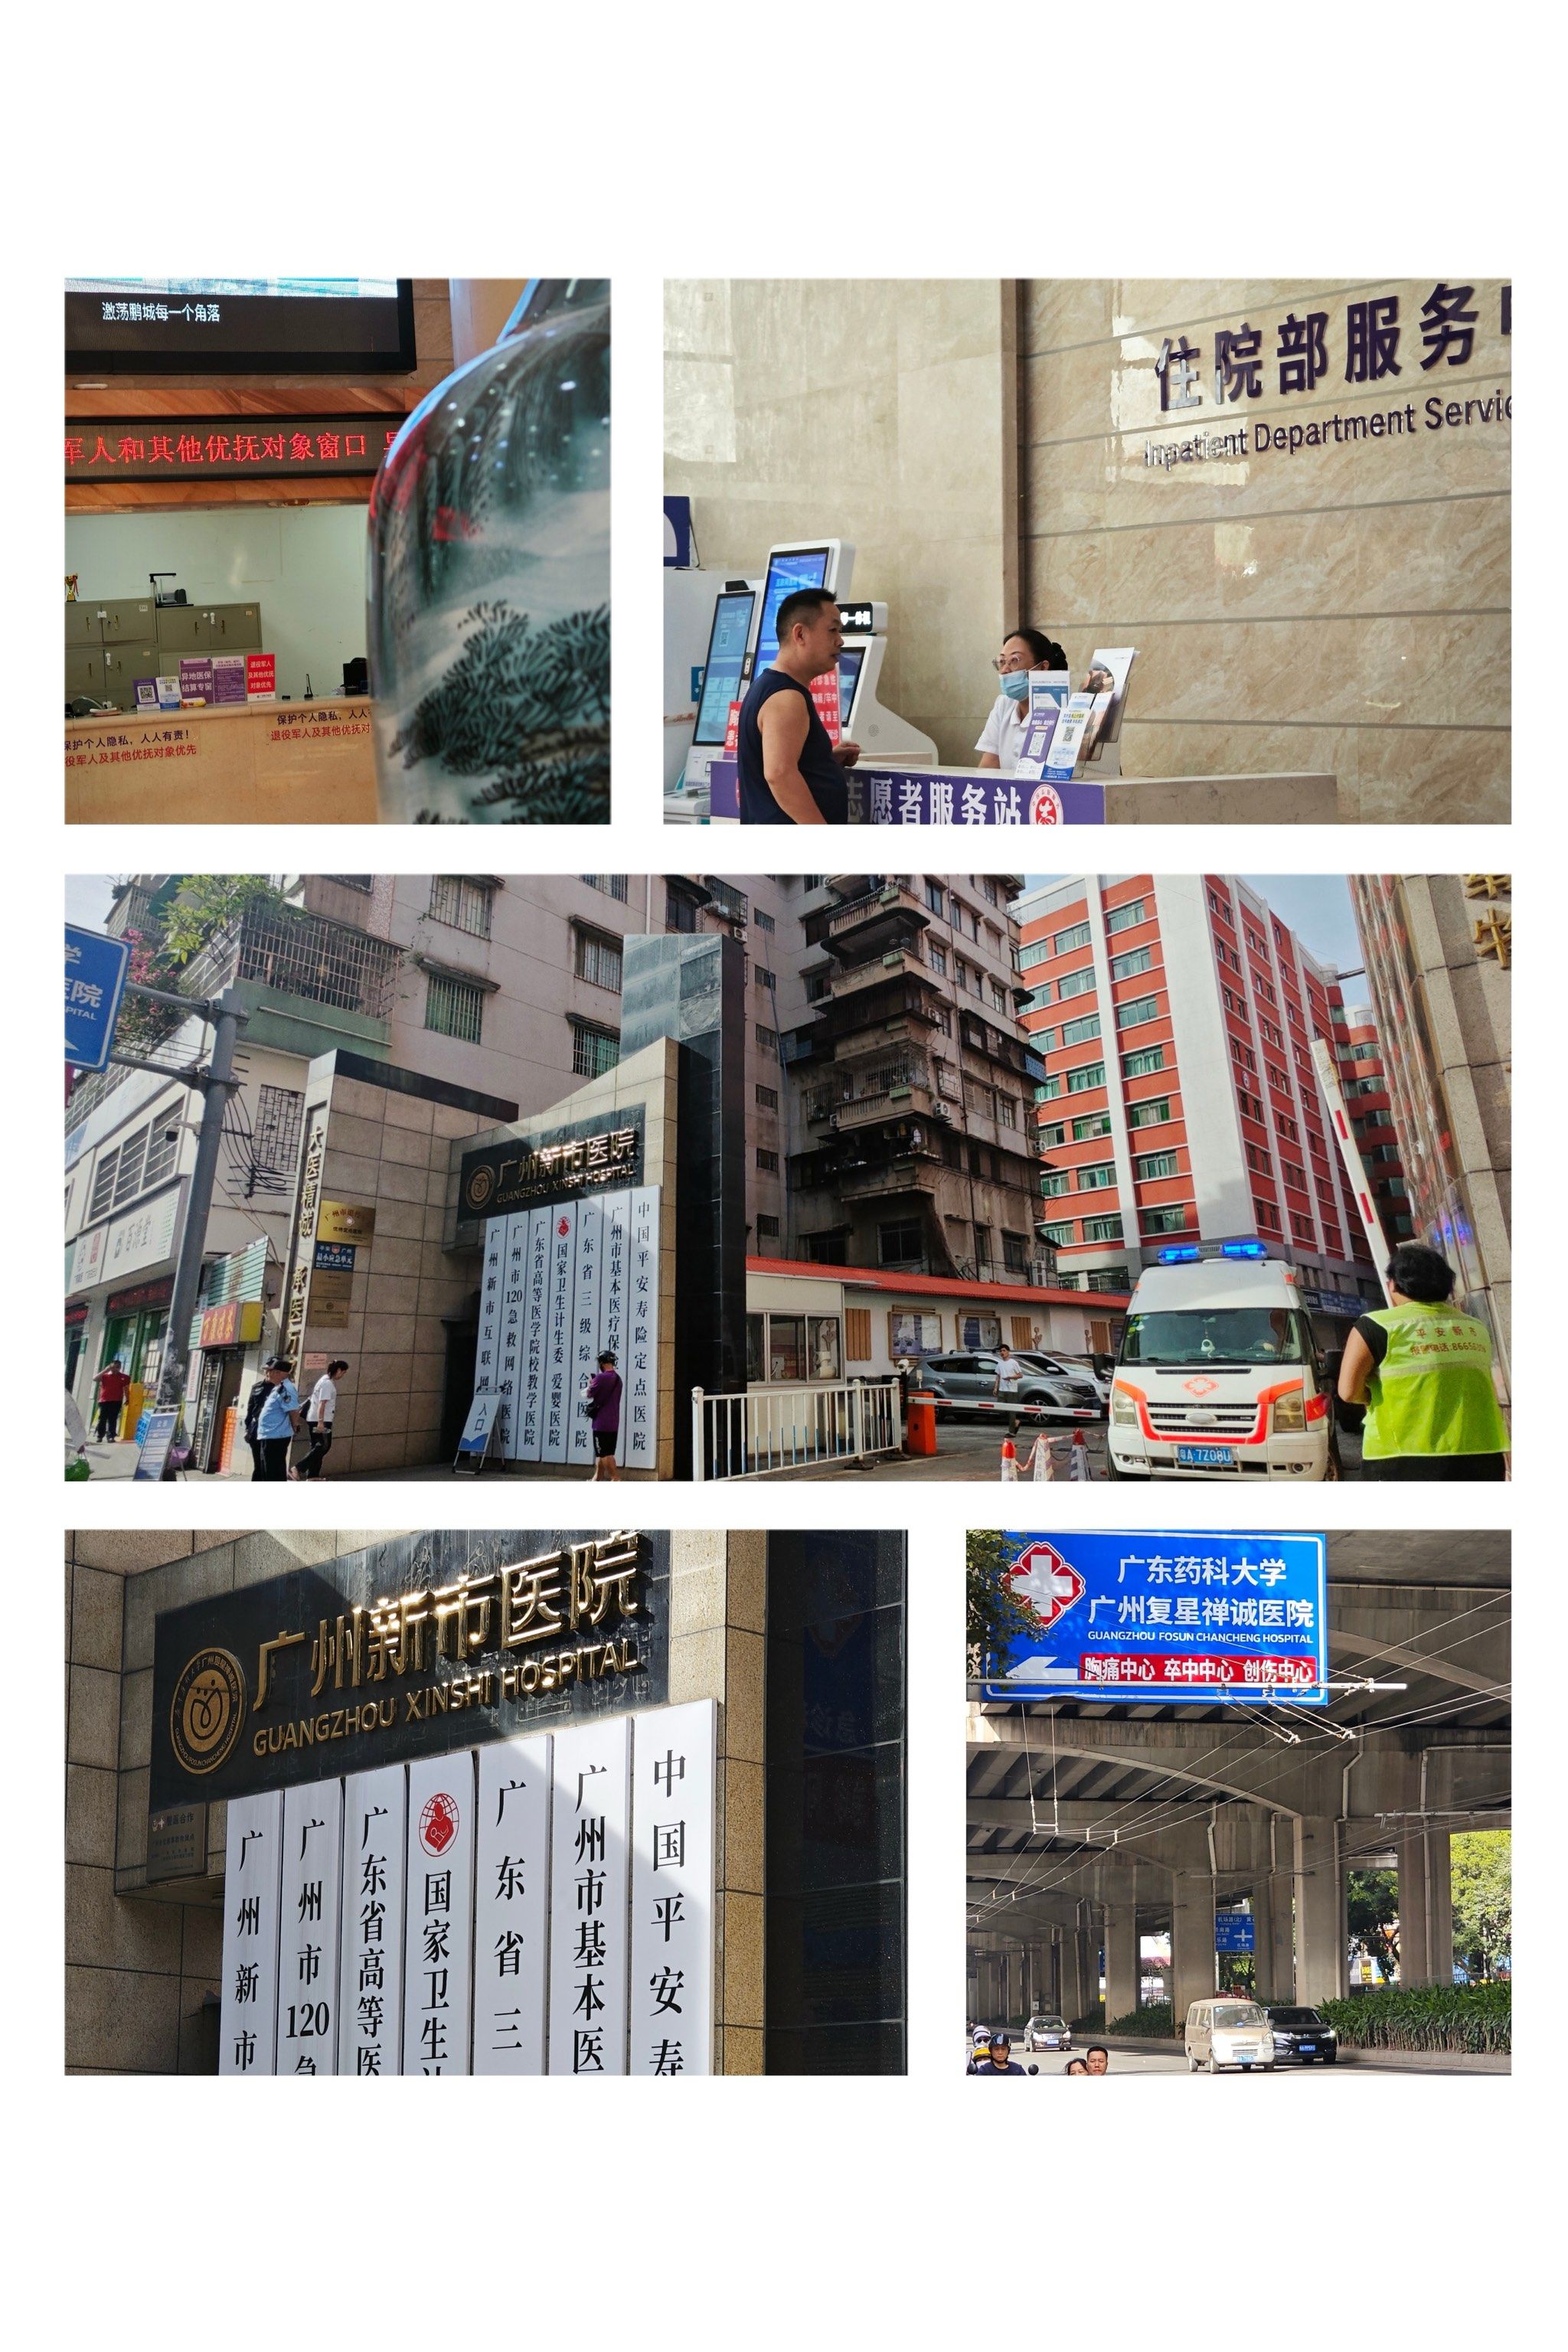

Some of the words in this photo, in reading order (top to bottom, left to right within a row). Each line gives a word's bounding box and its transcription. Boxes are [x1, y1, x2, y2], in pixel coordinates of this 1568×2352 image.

[102, 302, 220, 322] 激荡鹏城每一个角落
[1155, 282, 1512, 412] 住院部服务
[64, 432, 366, 466] 军人和其他优抚对象窗口
[1143, 426, 1249, 472] Inpatient
[1255, 402, 1417, 456] Department
[181, 671, 213, 681] 异地医保
[276, 708, 371, 726] 保护个人隐私，人人
[496, 1127, 635, 1188] 广州新市医院
[496, 1183, 550, 1204] GUANGZHOU
[552, 1173, 583, 1191] XINSHI
[586, 1163, 635, 1183] HOSPITAL
[524, 1220, 546, 1446] 广东省高等医学院校教学医院
[551, 1243, 569, 1364] 国家卫生计生委
[632, 1201, 651, 1452] 中国平安寿险定点医院
[475, 1402, 487, 1432] 入口
[547, 1373, 563, 1446] 爱婴医院
[1117, 1554, 1287, 1587] 广东药科大学
[252, 1530, 639, 1713] 广州新市医院
[1087, 1595, 1315, 1628] 广州复星禅诚医院
[1087, 1631, 1156, 1642] GUANGZHOU
[1158, 1632, 1194, 1642] FOSUN
[1196, 1632, 1261, 1644] CHANCHENG
[1263, 1634, 1315, 1645] HOSPITAL
[253, 1695, 397, 1757] GUANGZHOU
[404, 1671, 492, 1723] XINSHI
[501, 1636, 639, 1700] HOSPITAL
[1084, 1656, 1156, 1682] 胸痛中心
[1163, 1658, 1235, 1682] 卒中中心
[1243, 1658, 1313, 1684] 创伤中心
[357, 1806, 389, 2076] 广东省高等医
[492, 1779, 528, 2050] 广东省三
[572, 1764, 608, 2076] 广州市基本医
[648, 1749, 687, 2076] 中国平安寿
[233, 1830, 264, 2072] 广州新市
[419, 1869, 452, 2076] 国家卫生
